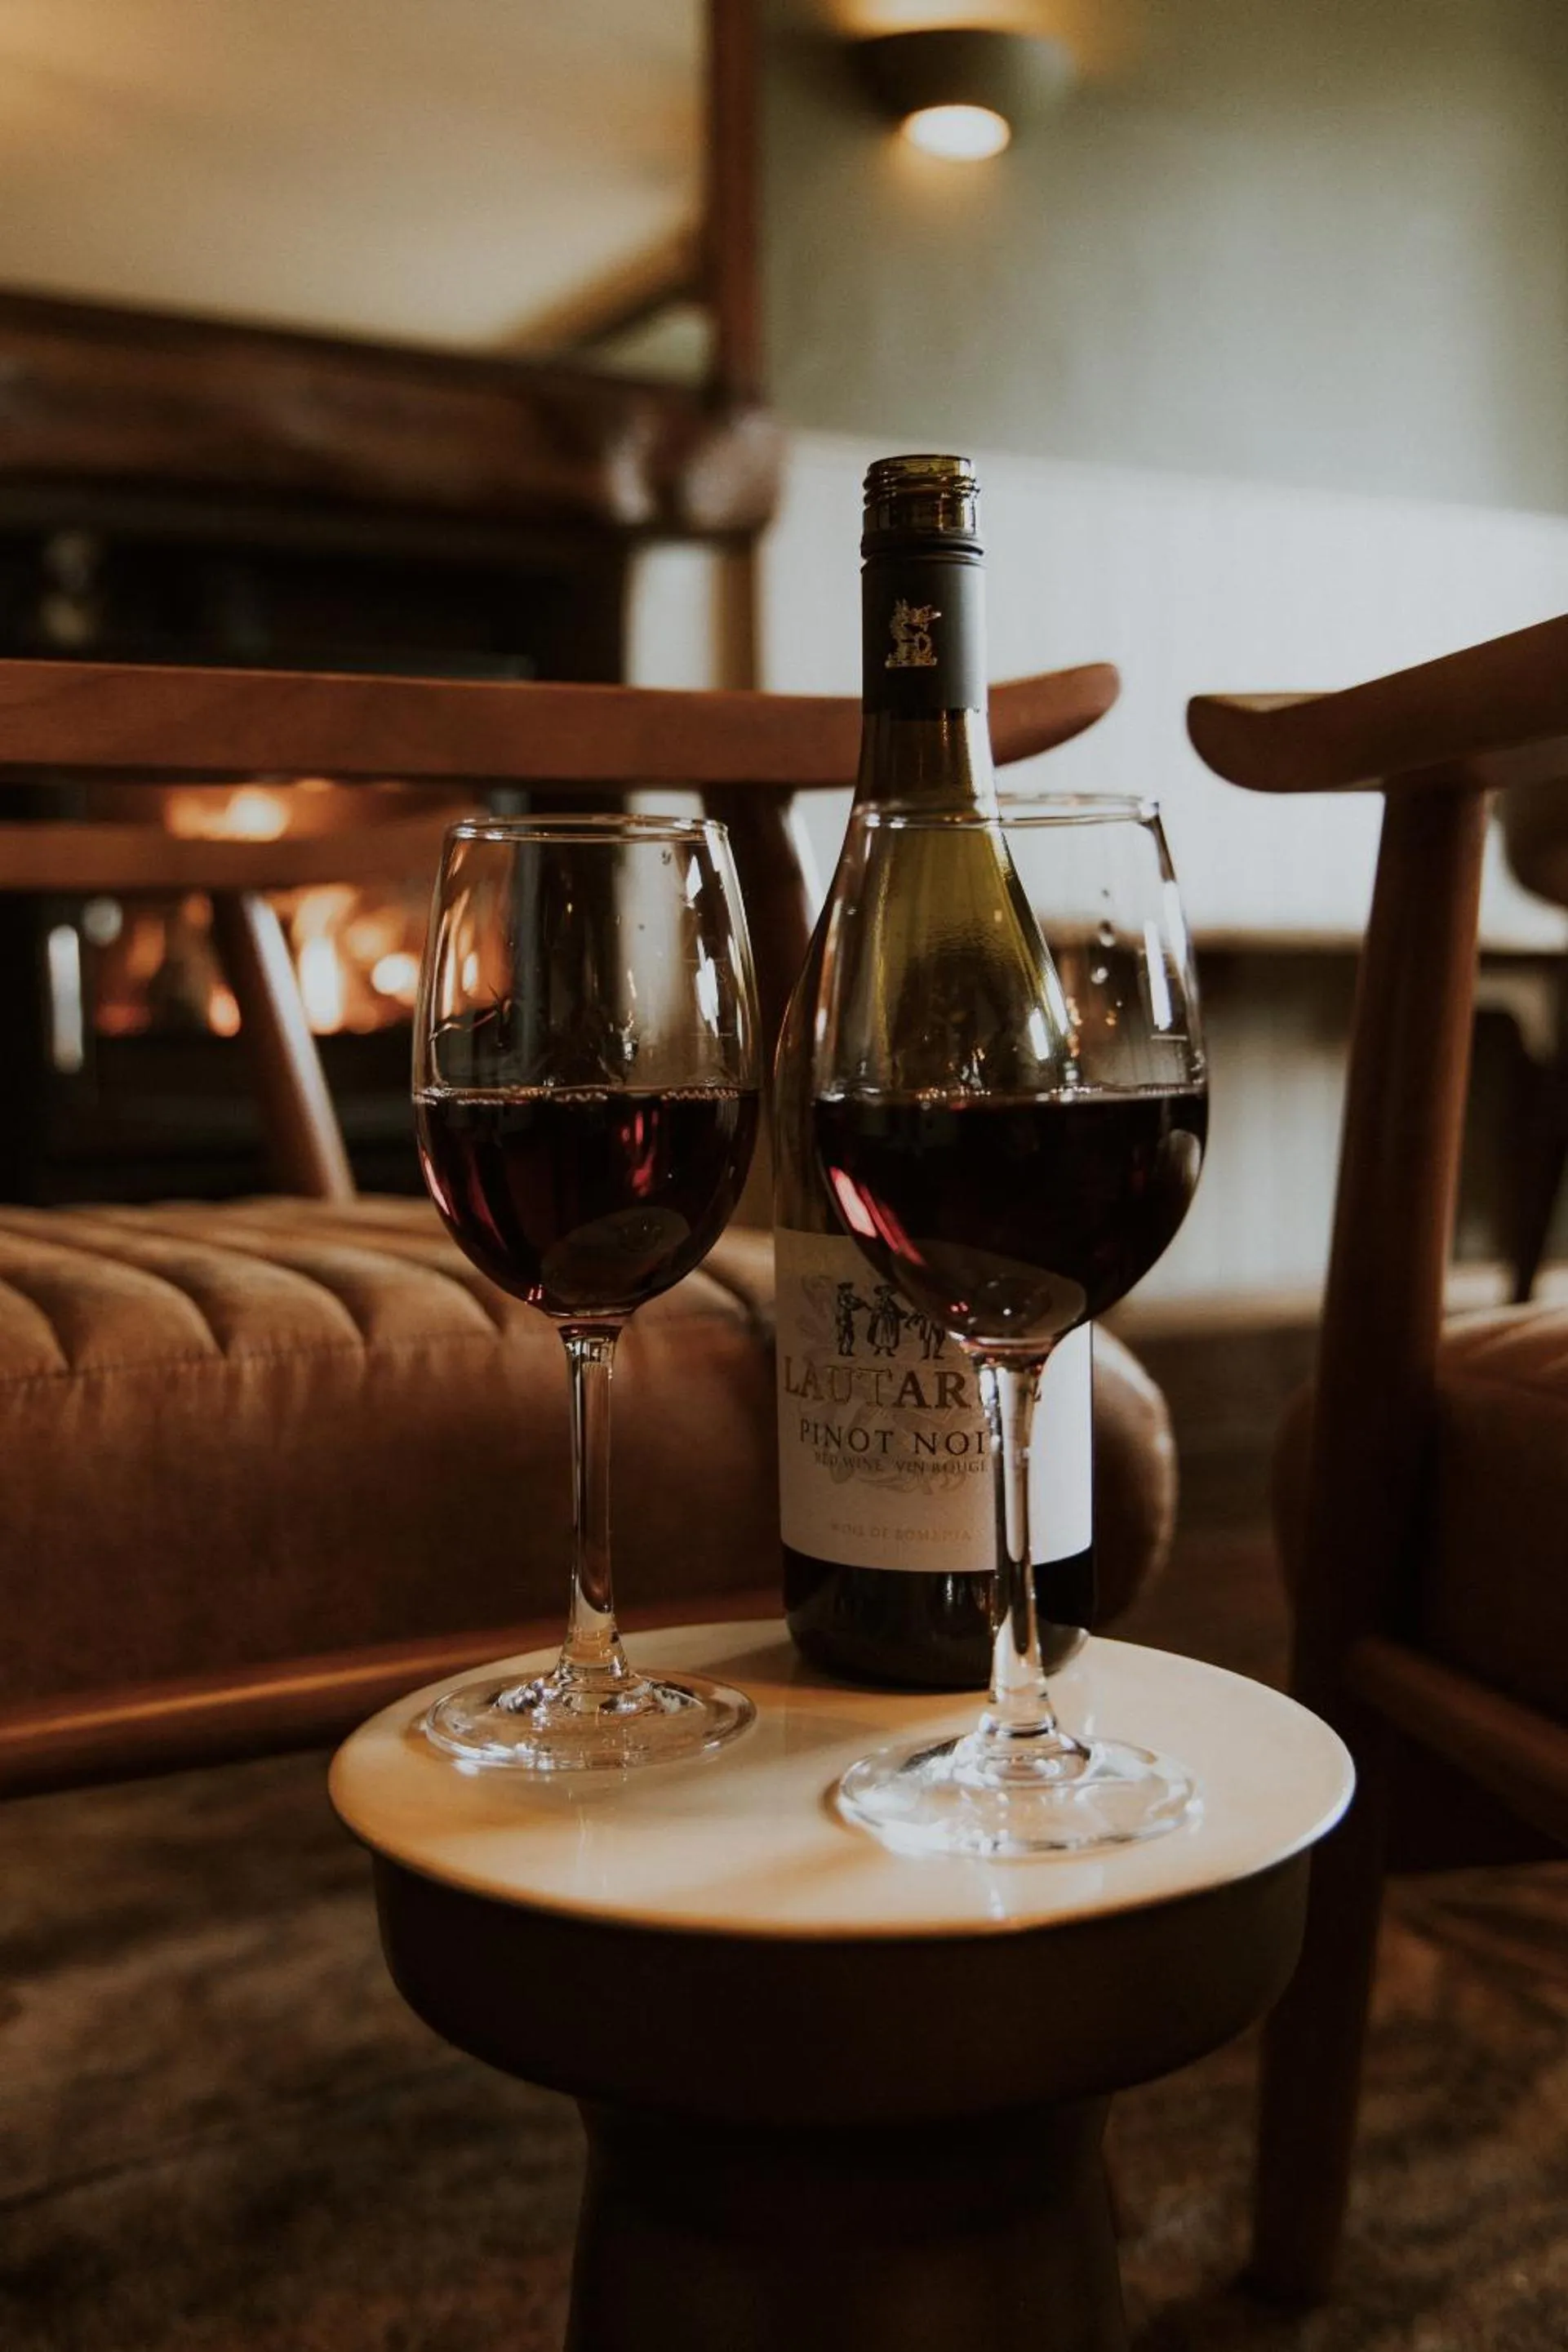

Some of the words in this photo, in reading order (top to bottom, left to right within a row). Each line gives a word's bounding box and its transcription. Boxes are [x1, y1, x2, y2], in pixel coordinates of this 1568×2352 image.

[784, 1356, 1042, 1409] LAUTAR
[800, 1418, 894, 1453] PINOT
[913, 1430, 985, 1456] NOI
[842, 1456, 884, 1472] WINE
